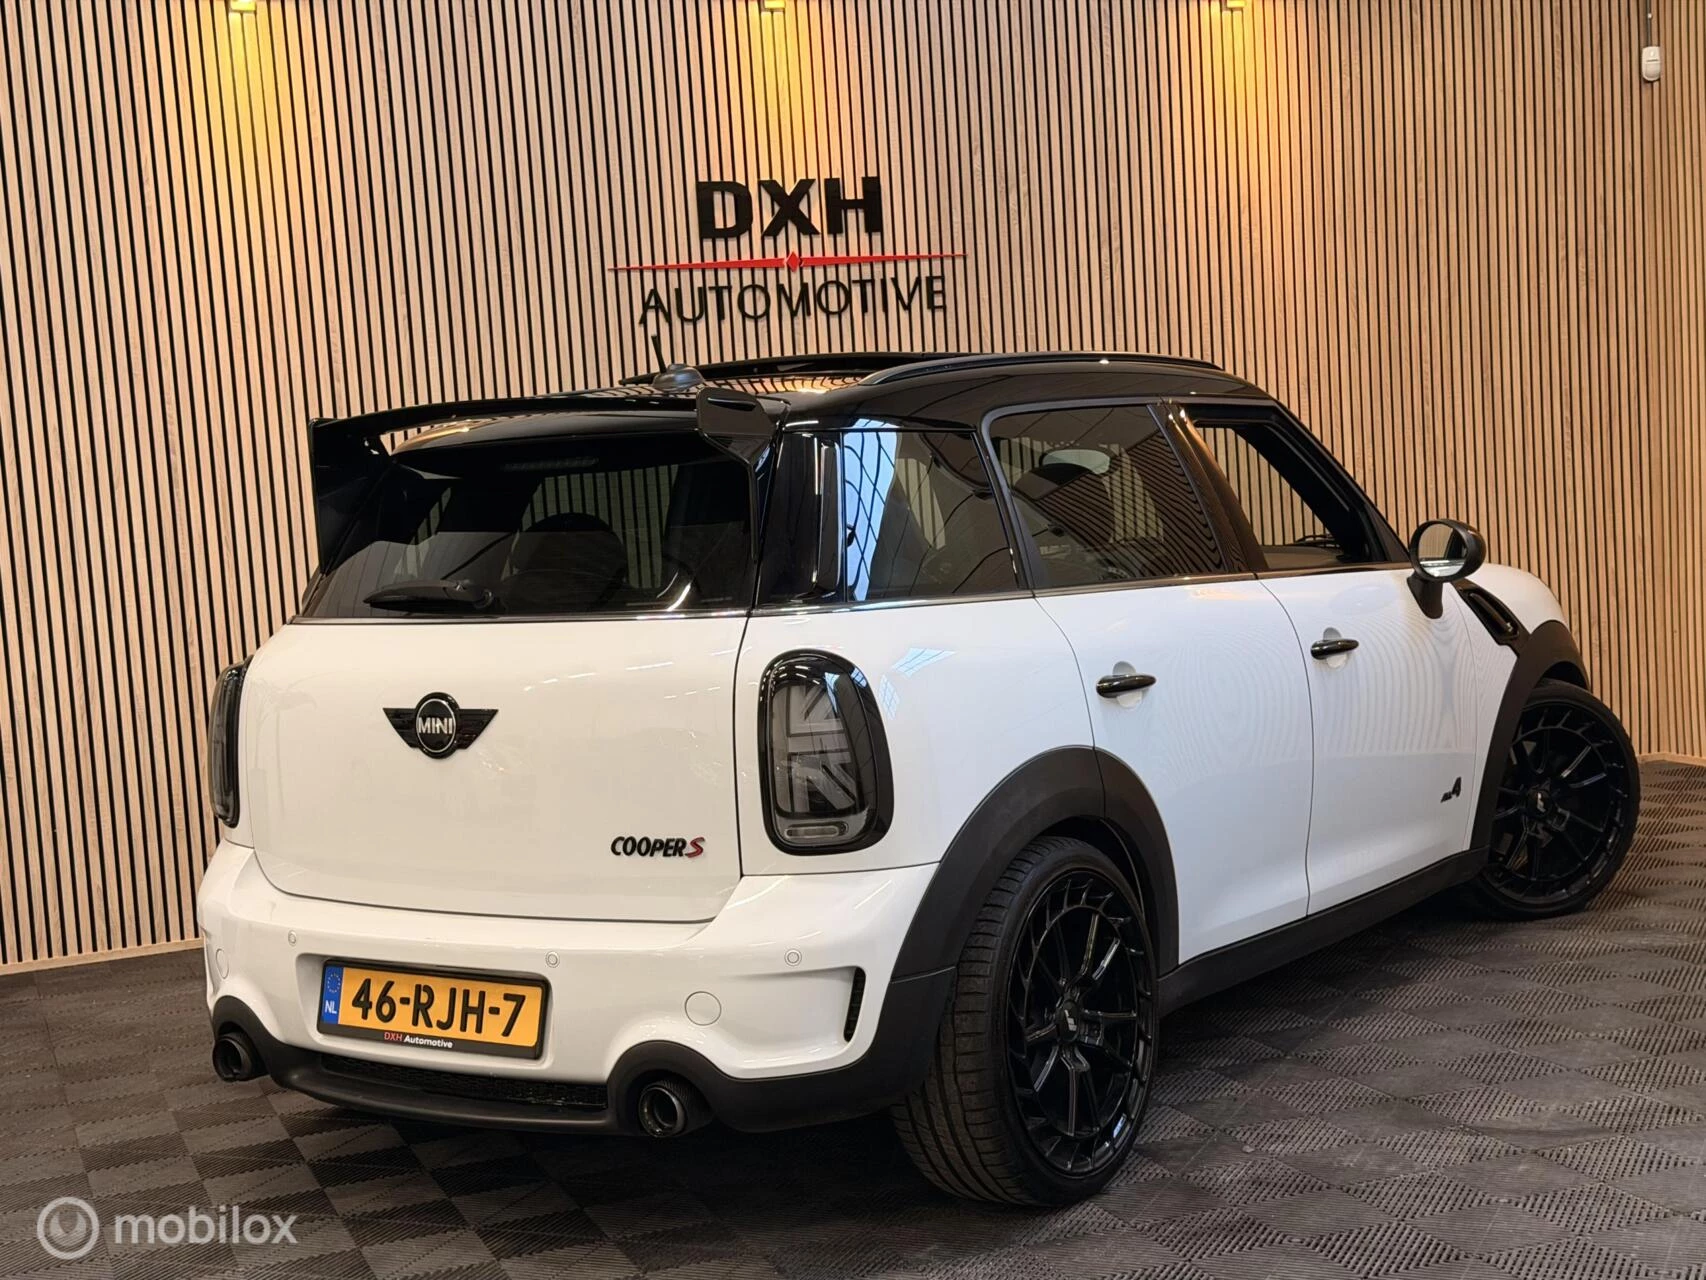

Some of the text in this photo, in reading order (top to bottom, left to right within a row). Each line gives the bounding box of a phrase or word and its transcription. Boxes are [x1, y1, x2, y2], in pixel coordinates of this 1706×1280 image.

[698, 176, 883, 239] DXH
[639, 275, 946, 325] AUTOMOTIVE
[418, 717, 453, 734] MINI
[324, 1000, 337, 1014] NL
[352, 978, 526, 1037] 46-RJH-7
[384, 1032, 453, 1048] DXH Automotive
